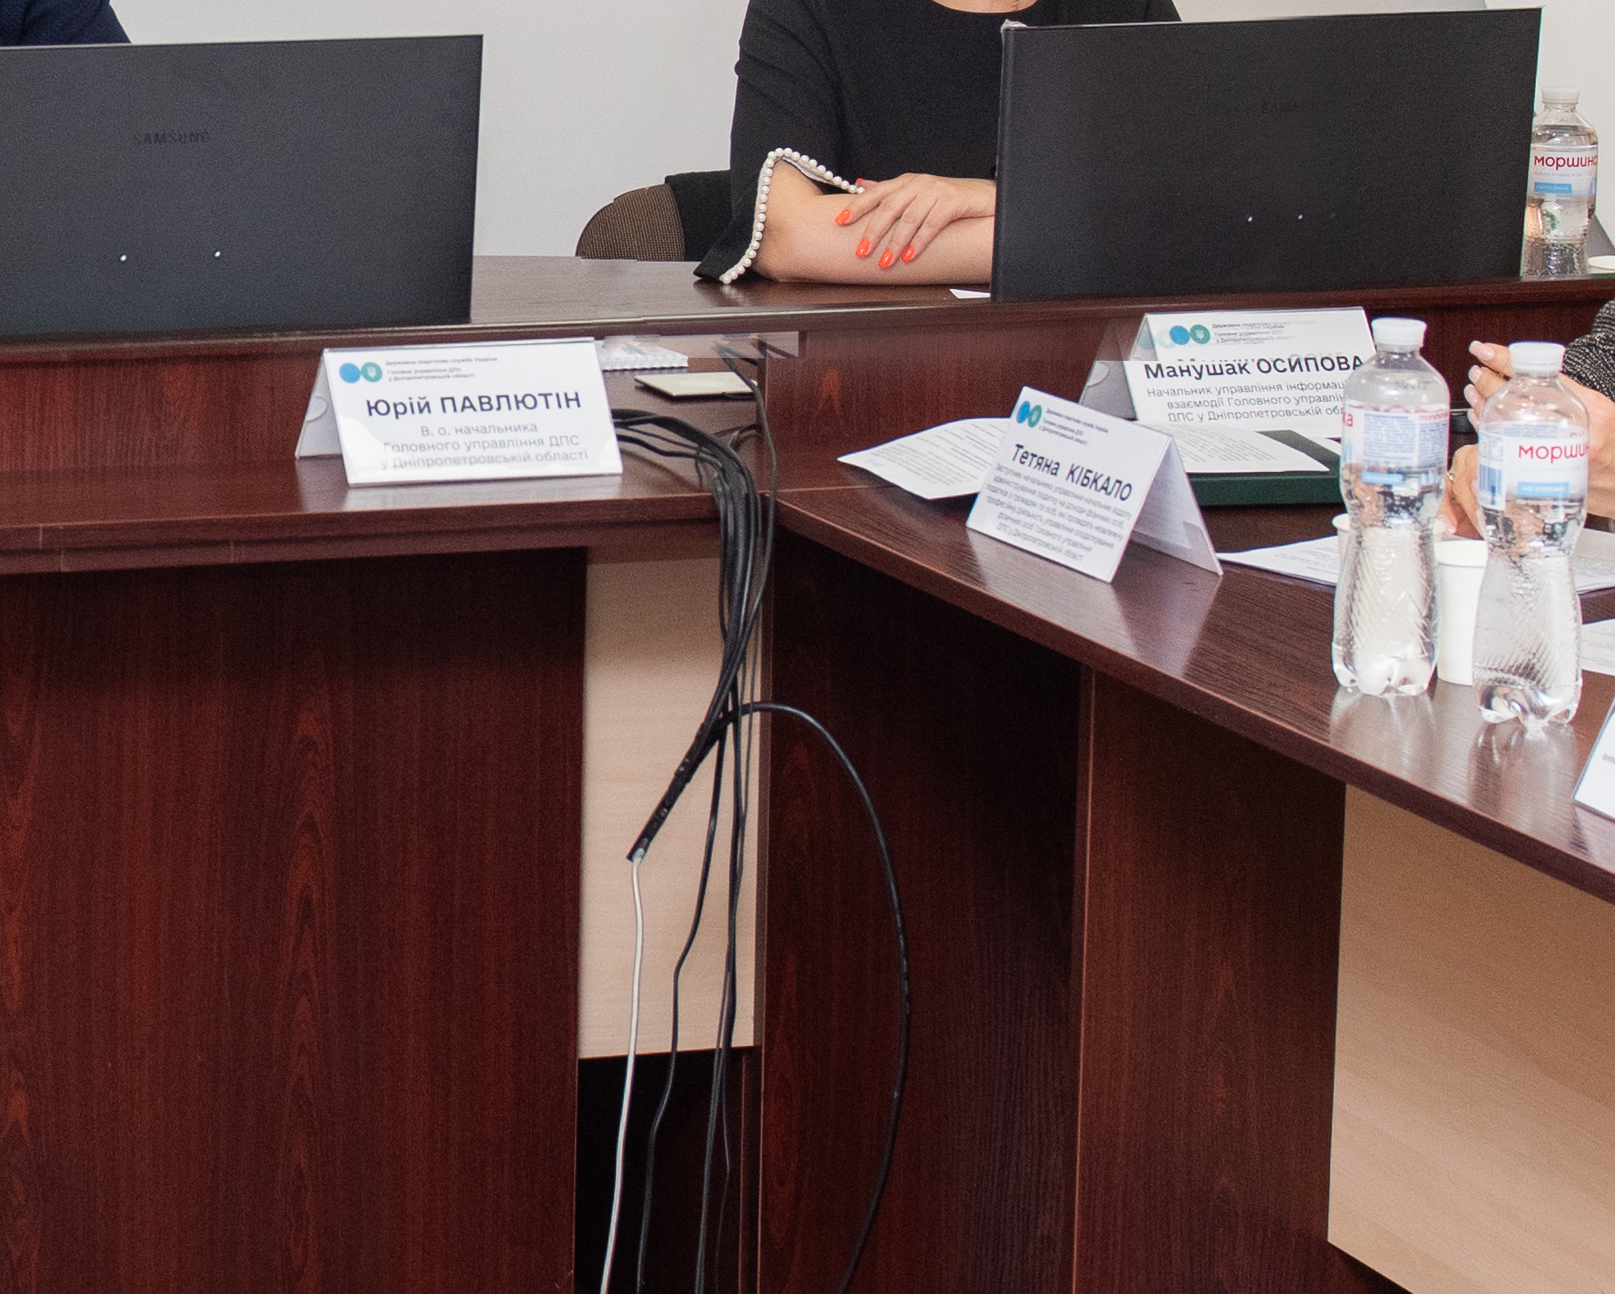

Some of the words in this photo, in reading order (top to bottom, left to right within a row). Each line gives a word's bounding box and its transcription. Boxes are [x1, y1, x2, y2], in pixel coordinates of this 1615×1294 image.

[132, 130, 212, 146] SAMSUNG
[1144, 361, 1251, 380] Манушак
[1257, 355, 1364, 373] ОСИПОВА
[1147, 387, 1212, 397] Начальник
[1215, 383, 1282, 396] управління
[1286, 380, 1346, 393] інформац
[366, 396, 431, 419] Юрій
[441, 391, 581, 414] ПАВЛЮТІН
[1167, 397, 1224, 410] взаємодії
[1228, 395, 1291, 406] Головного
[1293, 393, 1345, 406] управлін
[1168, 412, 1194, 422] ДПС
[1208, 407, 1322, 422] Дніпропетровській
[420, 425, 434, 437] В.
[455, 422, 538, 435] начальника
[384, 440, 460, 453] Головного
[465, 437, 544, 451] управління
[549, 435, 579, 449] ДПС
[1518, 442, 1590, 464] морши
[392, 453, 531, 470] Дніпропетровській
[535, 450, 588, 462] області
[1012, 443, 1060, 476] Тетяна
[1065, 463, 1133, 501] КІБКАЛО
